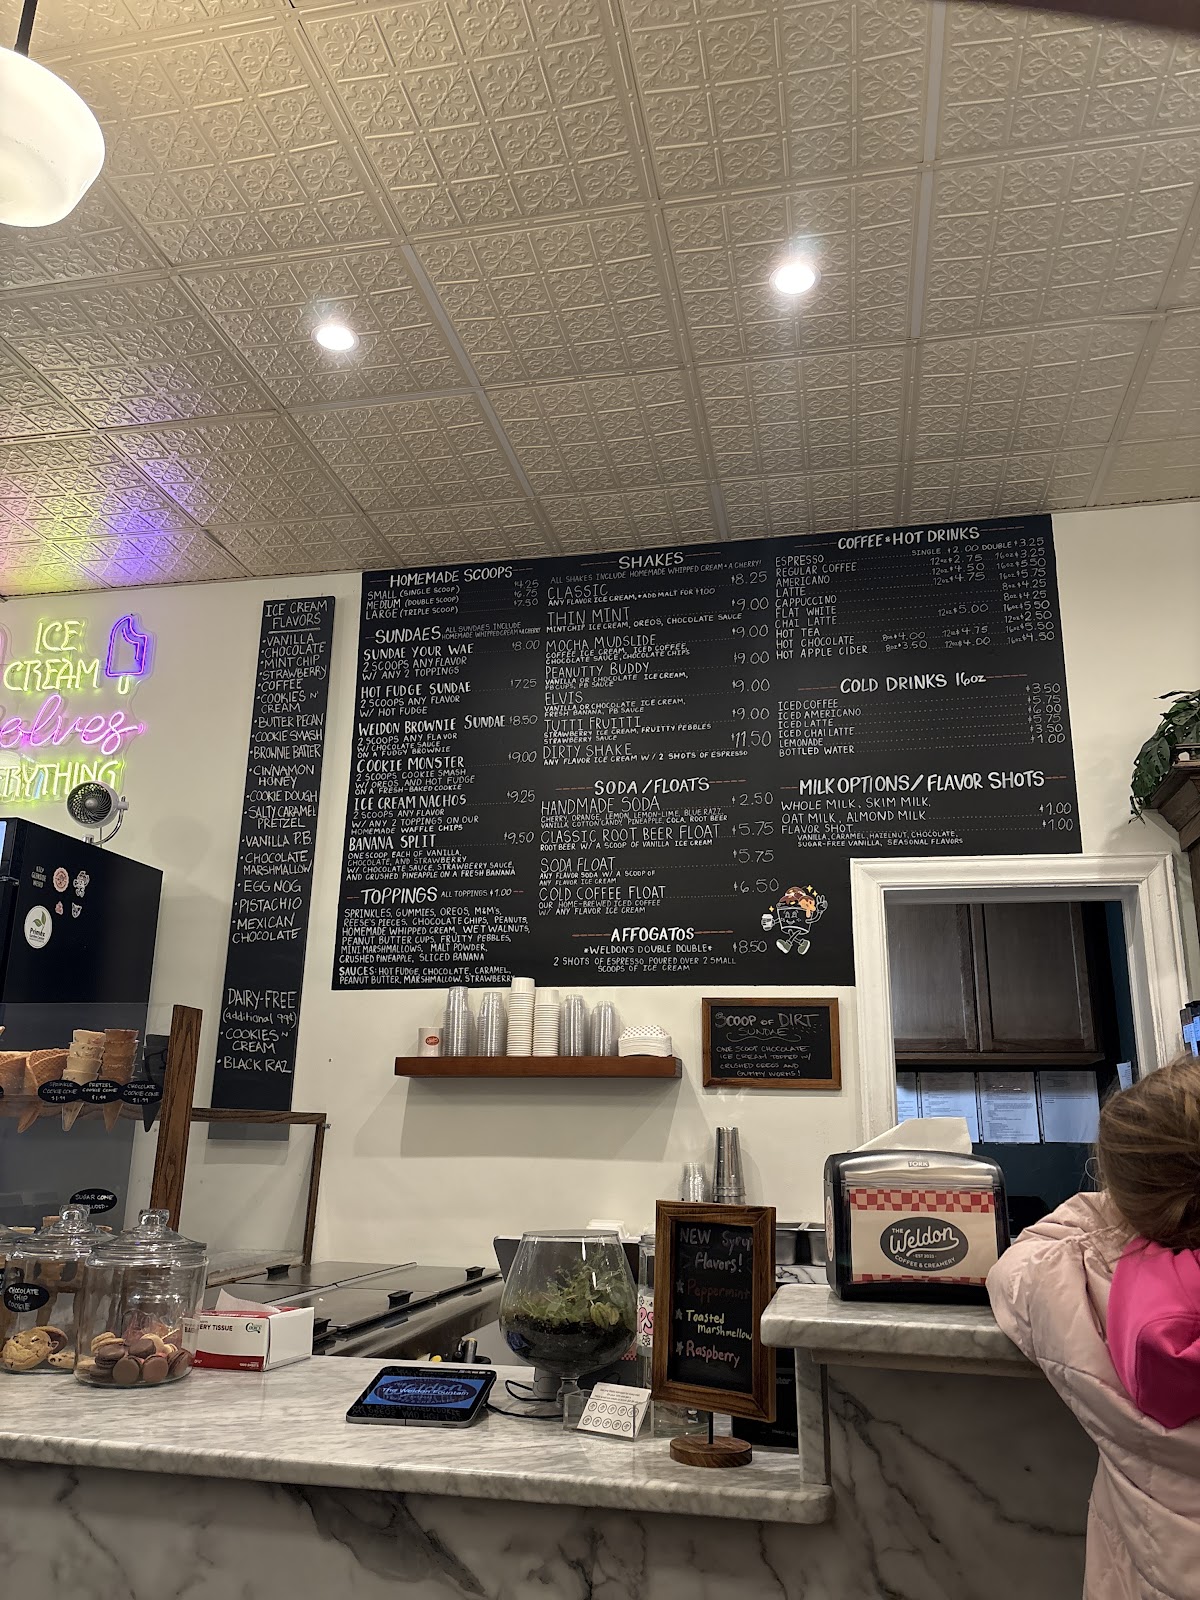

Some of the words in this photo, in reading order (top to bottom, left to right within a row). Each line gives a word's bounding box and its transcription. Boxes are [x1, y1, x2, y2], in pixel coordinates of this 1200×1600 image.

[838, 533, 884, 549] COFFEE
[892, 531, 924, 546] HOT
[927, 526, 980, 542] DRINKS
[618, 552, 684, 569] SHAKES
[775, 555, 824, 567] ESPRESSO
[390, 571, 460, 588] HOMEMADE
[464, 566, 512, 582] SCOOPS
[548, 584, 608, 600] CLASSIC
[731, 571, 768, 585] $8.25
[368, 591, 397, 600] SMALL
[775, 595, 836, 608] CAPPUCCINO
[265, 604, 286, 617] ICE
[290, 600, 327, 614] CREAM
[366, 600, 400, 610] MEDIUM
[547, 609, 585, 625] THIN
[592, 607, 630, 623] MINT
[731, 597, 769, 611] $9.00
[273, 612, 321, 629] FLAVORS
[366, 609, 397, 620] LARGE
[35, 620, 81, 654] ICE
[267, 633, 314, 646] VANILLA
[375, 626, 441, 644] SUNDAES
[264, 642, 326, 658] CHOCOLATE
[363, 647, 406, 661] SUNDAE
[412, 646, 441, 657] YOUR
[448, 643, 473, 655] WAE
[512, 640, 540, 650] $8.00
[777, 650, 793, 660] HOT
[800, 648, 832, 658] APPLE
[839, 645, 868, 655] CIDER
[3, 658, 100, 691] CREAM
[262, 665, 327, 680] STRAWBERRY
[545, 664, 603, 680] PEANUTTY
[611, 662, 649, 675] BUDDY
[261, 678, 303, 692] COFFEE
[361, 686, 380, 699] HOT
[386, 684, 422, 697] FUDGE
[429, 682, 471, 694] SUNDAE
[840, 678, 878, 693] COLD
[886, 674, 947, 691] DRINKS
[956, 672, 986, 686] 16oz
[260, 690, 306, 704] COOKIES
[544, 691, 583, 705] ELVIS
[261, 703, 301, 714] CREAM
[258, 716, 295, 728] BUTTER
[297, 713, 323, 727] PECAN
[358, 722, 400, 736] WELDON
[405, 718, 456, 733] BROWNIE
[464, 715, 505, 729] SUNDAE
[544, 719, 583, 732] TUTTI
[589, 716, 641, 729] FRUITTI
[255, 730, 288, 742] COOKIE
[290, 729, 322, 741] SMASH
[779, 729, 801, 738] ICED
[804, 729, 826, 738] CHAI
[829, 727, 855, 736] LATTE
[543, 745, 581, 759] DIRTY
[586, 743, 632, 757] SHAKE
[731, 731, 772, 748] $11.50
[779, 738, 823, 748] LEMONADE
[779, 747, 819, 757] BOTTLED
[824, 745, 854, 755] WATER
[254, 746, 290, 760] BROWNIE
[292, 744, 321, 759] BATTER
[611, 754, 637, 762] CREAM
[711, 750, 748, 758] ESPRESSO
[357, 759, 402, 773] COOKIE
[408, 756, 464, 770] MONSTER
[800, 777, 835, 795] MILK
[988, 770, 1045, 789] SHOTS
[354, 797, 374, 811] ICE
[378, 795, 416, 810] CREAM
[420, 794, 466, 808] NACHOS
[541, 797, 614, 815] HANDMADE
[621, 795, 660, 812] SODA
[732, 792, 773, 806] $2.50
[781, 800, 821, 811] WHOLE
[866, 797, 896, 808] SKIM
[540, 828, 598, 844] CLASSIC
[603, 827, 637, 842] ROOT
[643, 826, 674, 840] BEER
[679, 823, 720, 839] FLOAT
[782, 825, 820, 834] FLAVOR
[825, 824, 853, 832] SHOT
[1042, 818, 1073, 831] $1.00
[246, 835, 290, 847] VANILLA
[293, 831, 312, 845] P.B.
[349, 836, 394, 851] BANANA
[400, 834, 436, 848] SPLIT
[504, 831, 534, 844] $9.50
[244, 880, 270, 892] EGG
[274, 879, 301, 893] NOG
[361, 887, 438, 905] TOPPINGS
[454, 889, 487, 897] TOPPINGS
[490, 888, 512, 896] $1.00
[239, 897, 302, 914] PISTACHIO
[344, 909, 392, 918] SPRINKLES,
[396, 908, 437, 918] GUMMIES,
[440, 907, 470, 916] OREOS,
[237, 912, 295, 930] MEXICAN
[232, 928, 301, 943] CHOCOLATE
[610, 927, 694, 942] AFFOGATOS
[228, 988, 297, 1010] DAIRY-FREE
[715, 1012, 756, 1028] SCOOP
[778, 1013, 819, 1027] DIRT
[738, 1028, 789, 1036] SUNDAE
[224, 1056, 262, 1071] BLACK
[265, 1059, 292, 1073] RAZ
[680, 1228, 711, 1245] NEW
[722, 1231, 753, 1256] Syrup
[890, 1226, 959, 1257] Weldon
[895, 1255, 917, 1267] COFFEE
[924, 1257, 955, 1268] CREAMERY
[9, 1287, 39, 1296] CHOCOLATE
[686, 1310, 724, 1324] Toasted
[686, 1340, 740, 1368] Raspberry
